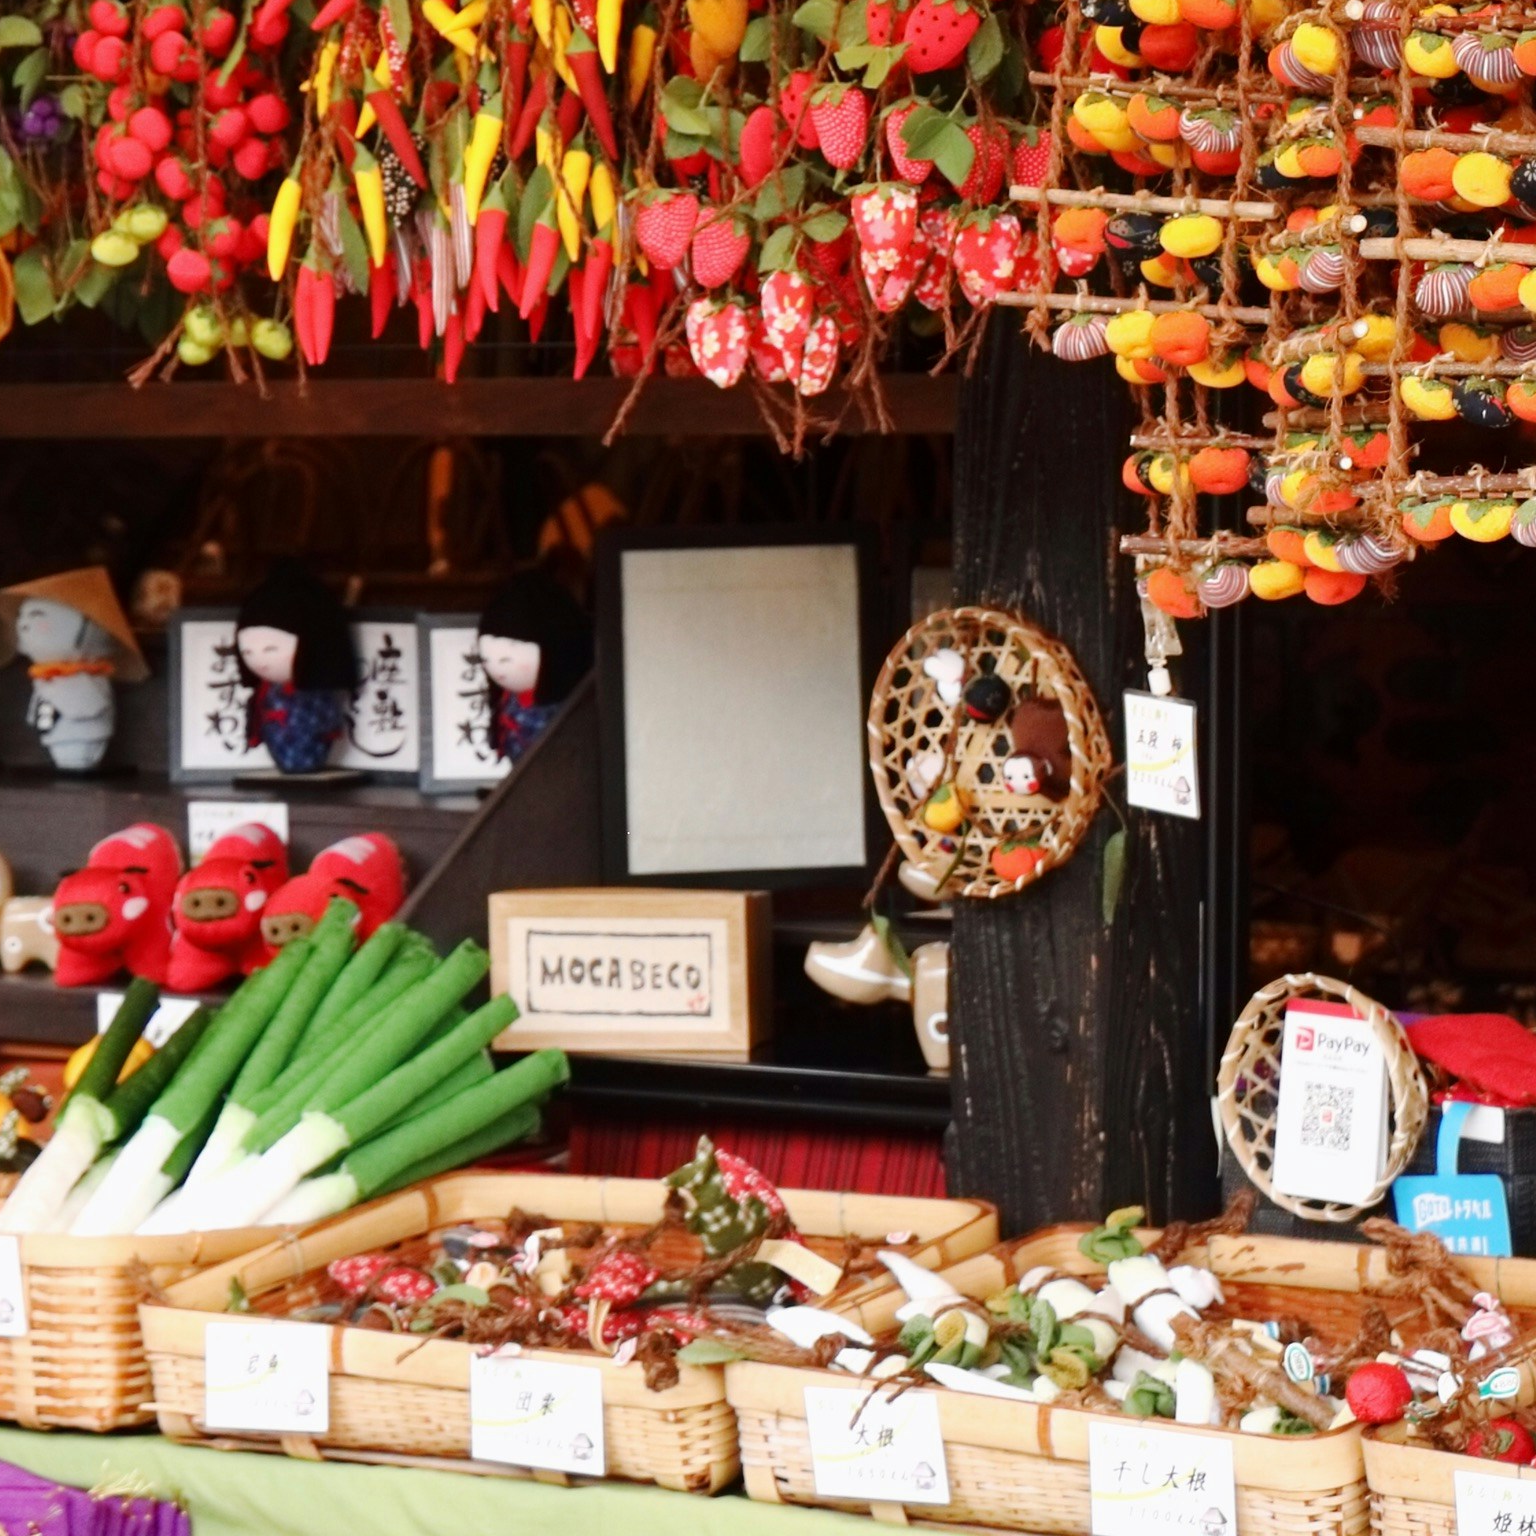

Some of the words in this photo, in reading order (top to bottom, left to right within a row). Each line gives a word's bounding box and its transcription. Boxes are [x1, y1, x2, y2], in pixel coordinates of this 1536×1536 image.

[540, 956, 702, 991] MOCABECO
[1317, 1032, 1371, 1057] PayPay
[855, 1422, 895, 1447] 大根
[1112, 1460, 1208, 1494] 干し大根
